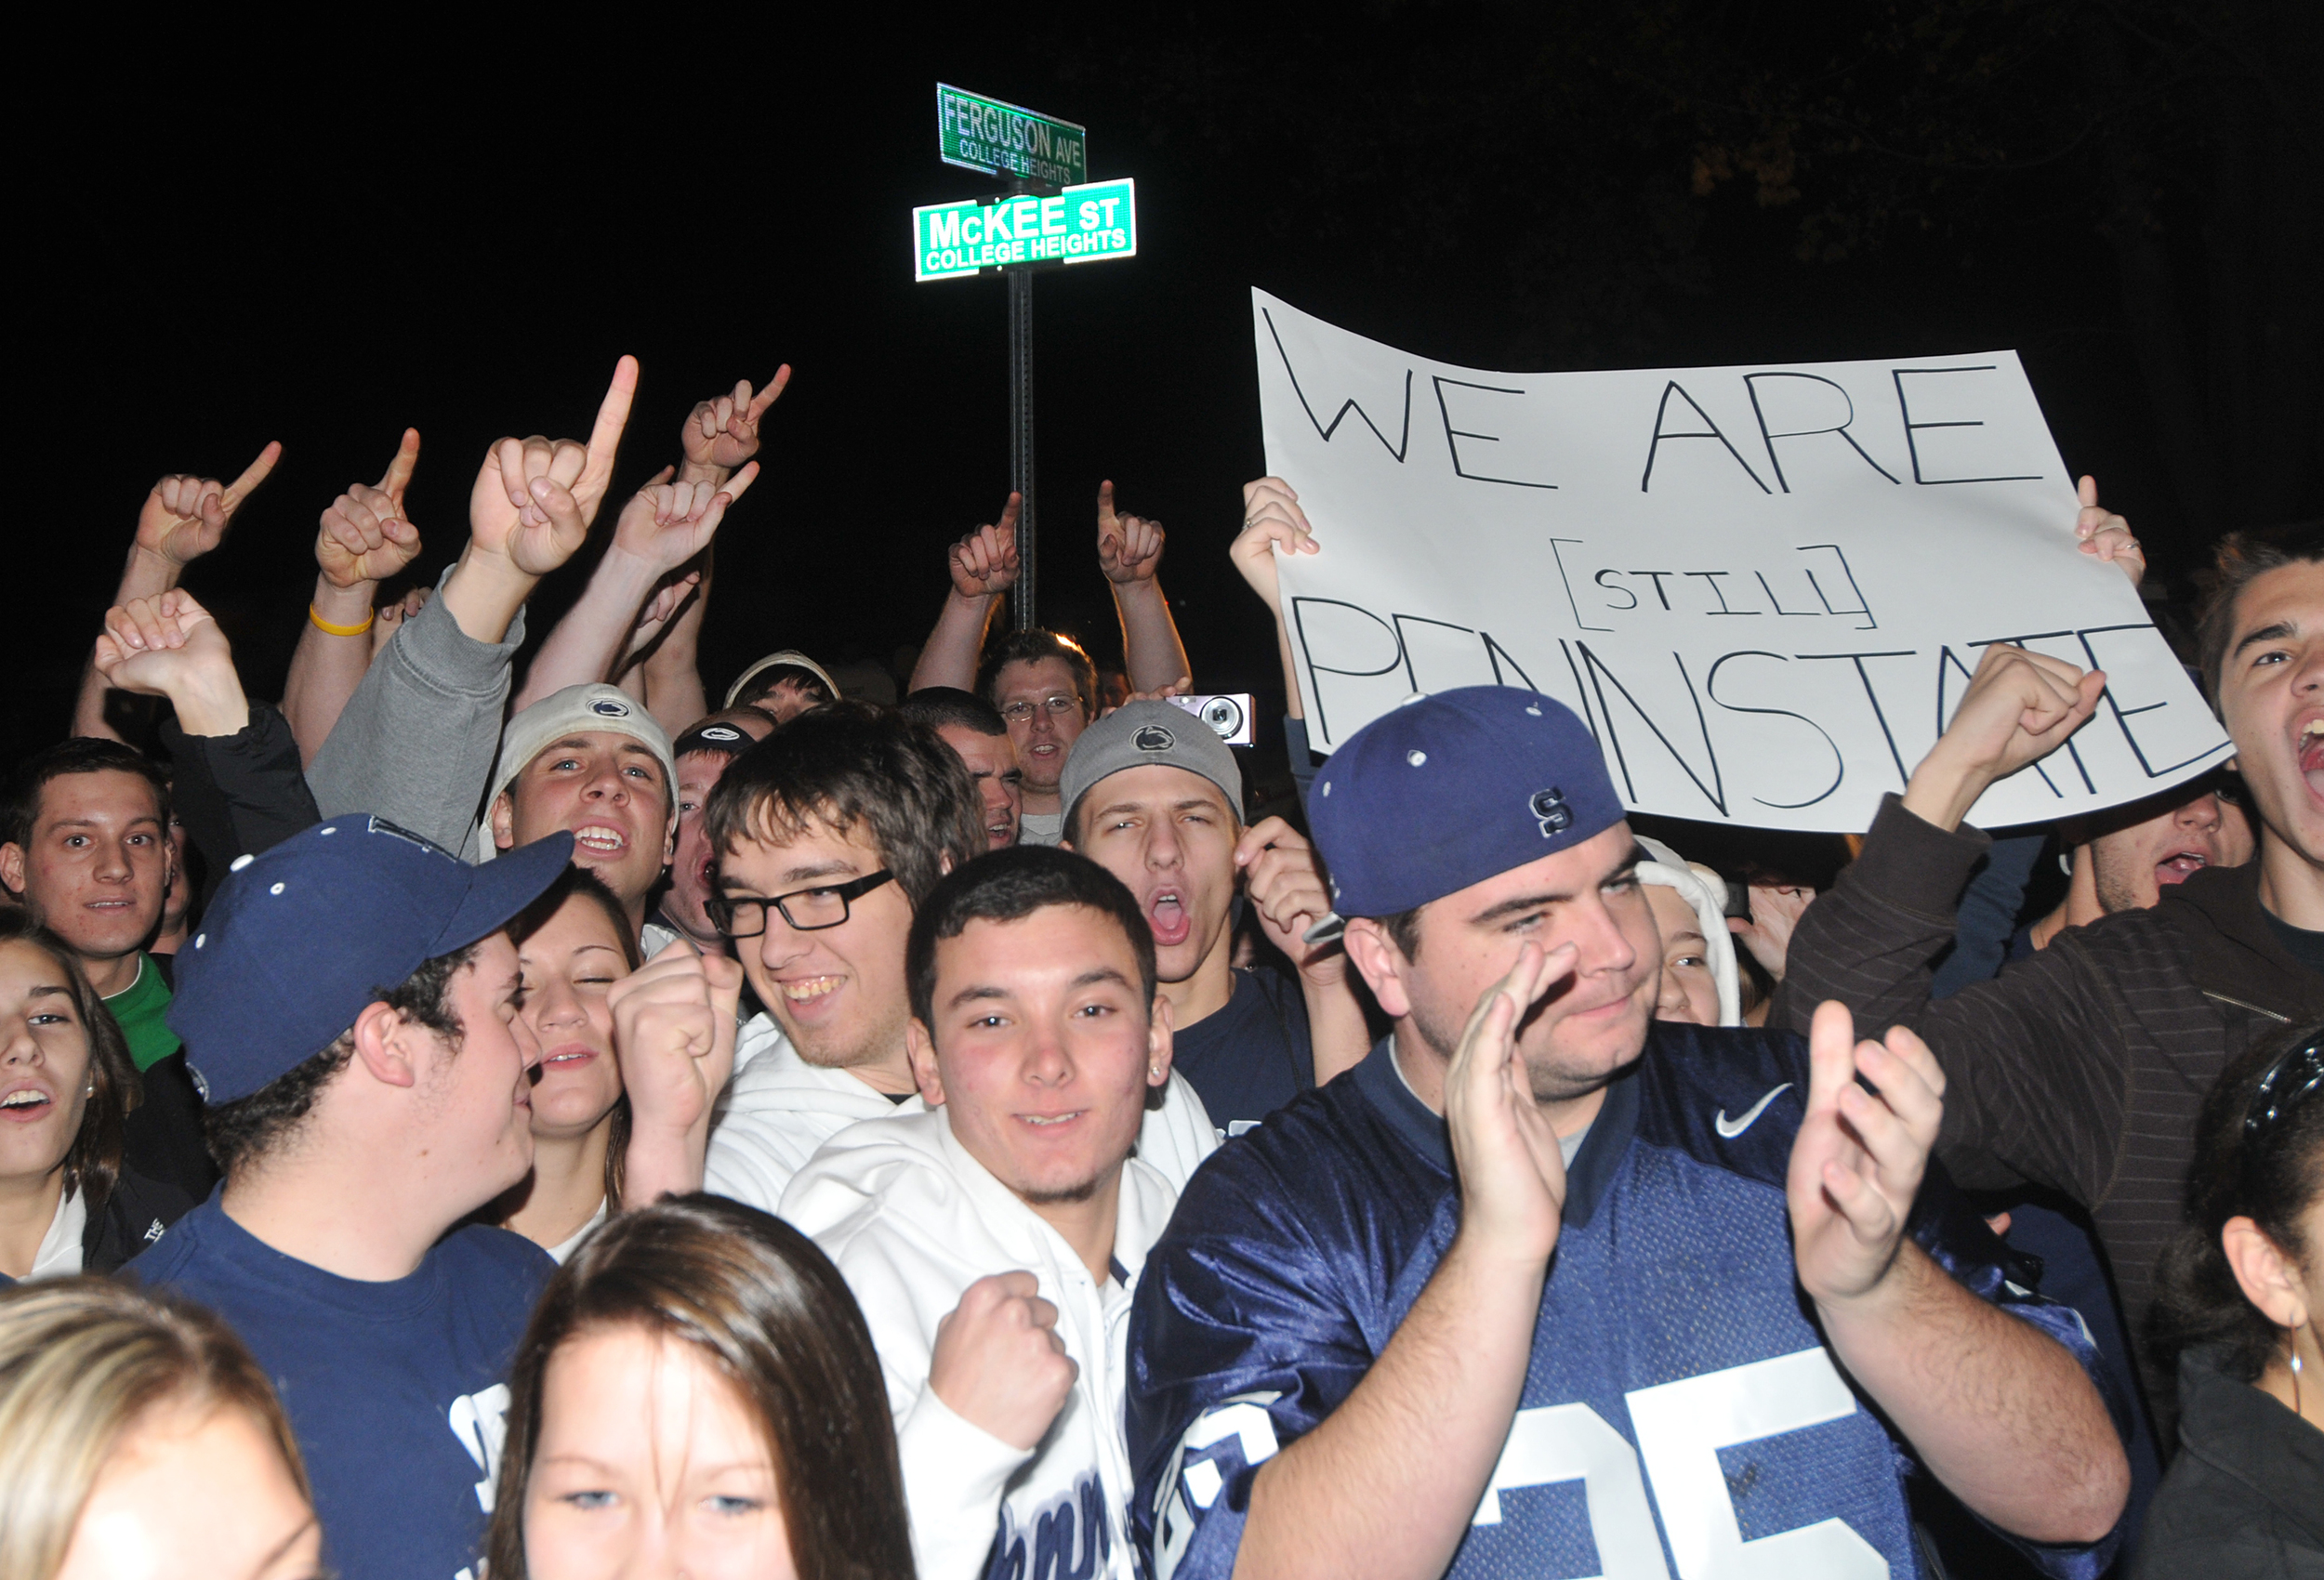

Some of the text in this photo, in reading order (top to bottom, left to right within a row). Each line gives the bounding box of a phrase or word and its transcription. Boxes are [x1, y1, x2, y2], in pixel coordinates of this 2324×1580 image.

[944, 93, 1082, 168] FERGUSON AVE
[959, 138, 1072, 185] COLLEGE HEIGHTS
[929, 196, 1121, 249] McKEE ST
[926, 229, 1127, 271] COLLEGE HEIGHTS
[1261, 306, 2044, 495] WE ARE
